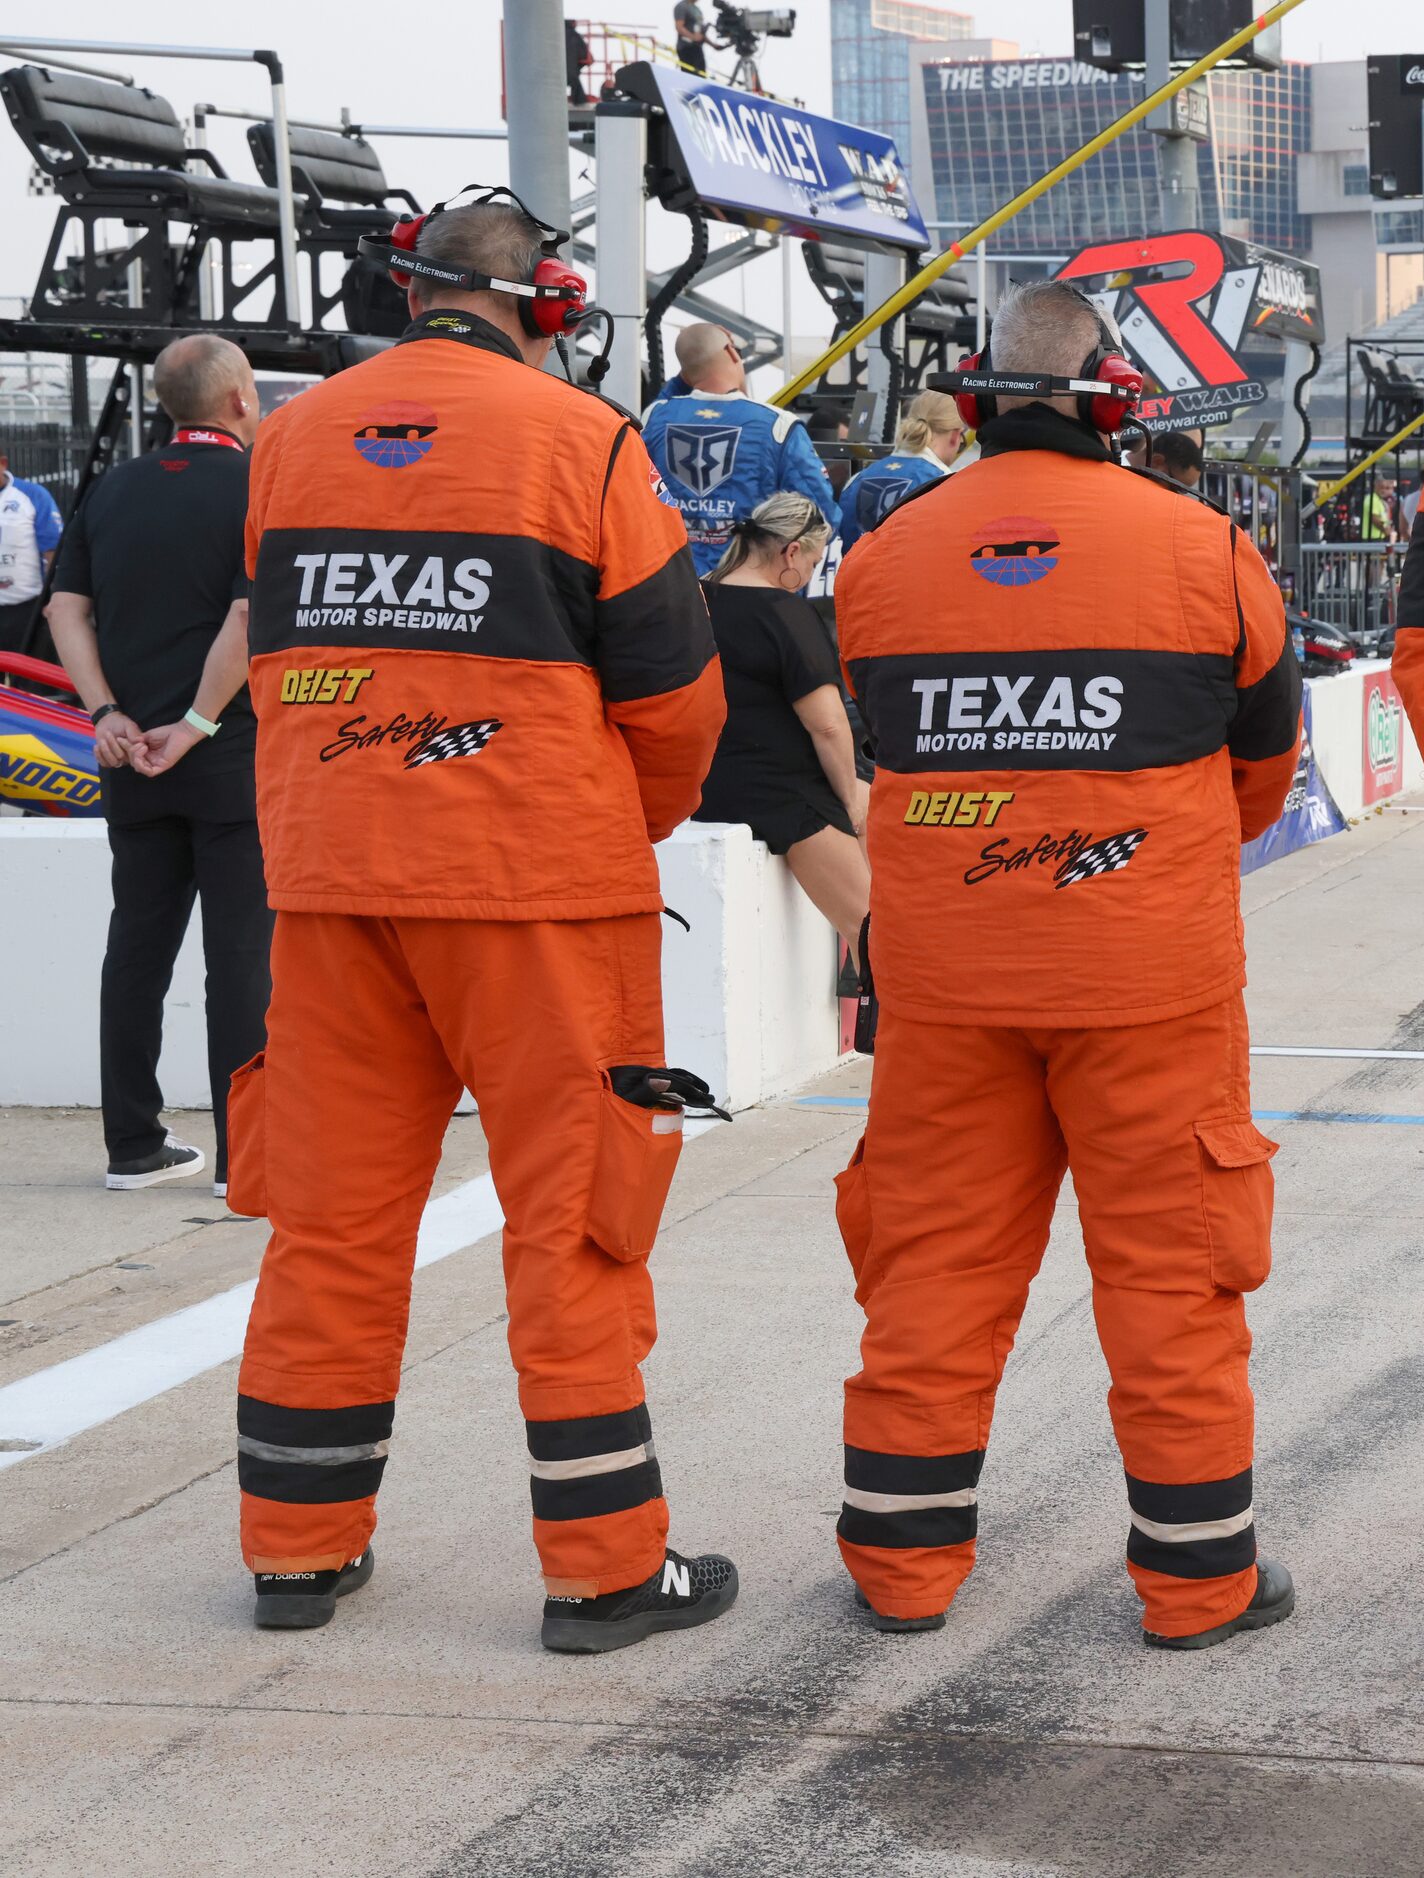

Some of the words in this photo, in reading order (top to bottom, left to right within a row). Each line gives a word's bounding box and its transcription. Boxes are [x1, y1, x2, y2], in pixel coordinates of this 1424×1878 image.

[939, 67, 984, 91] THE
[991, 62, 1117, 89] SPEEDWA
[700, 93, 828, 188] RACKLEY
[293, 553, 493, 611] TEXAS
[296, 608, 357, 628] MOTOR
[363, 609, 484, 633] SPEEDWAY
[280, 667, 375, 706] DEIST
[911, 675, 1124, 730] TEXAS
[319, 711, 448, 762] Safety
[916, 732, 987, 753] MOTOR
[992, 732, 1116, 751] SPEEDWAY
[903, 791, 1016, 828] DEIST
[964, 829, 1093, 885] Safety
[661, 1559, 691, 1597] N
